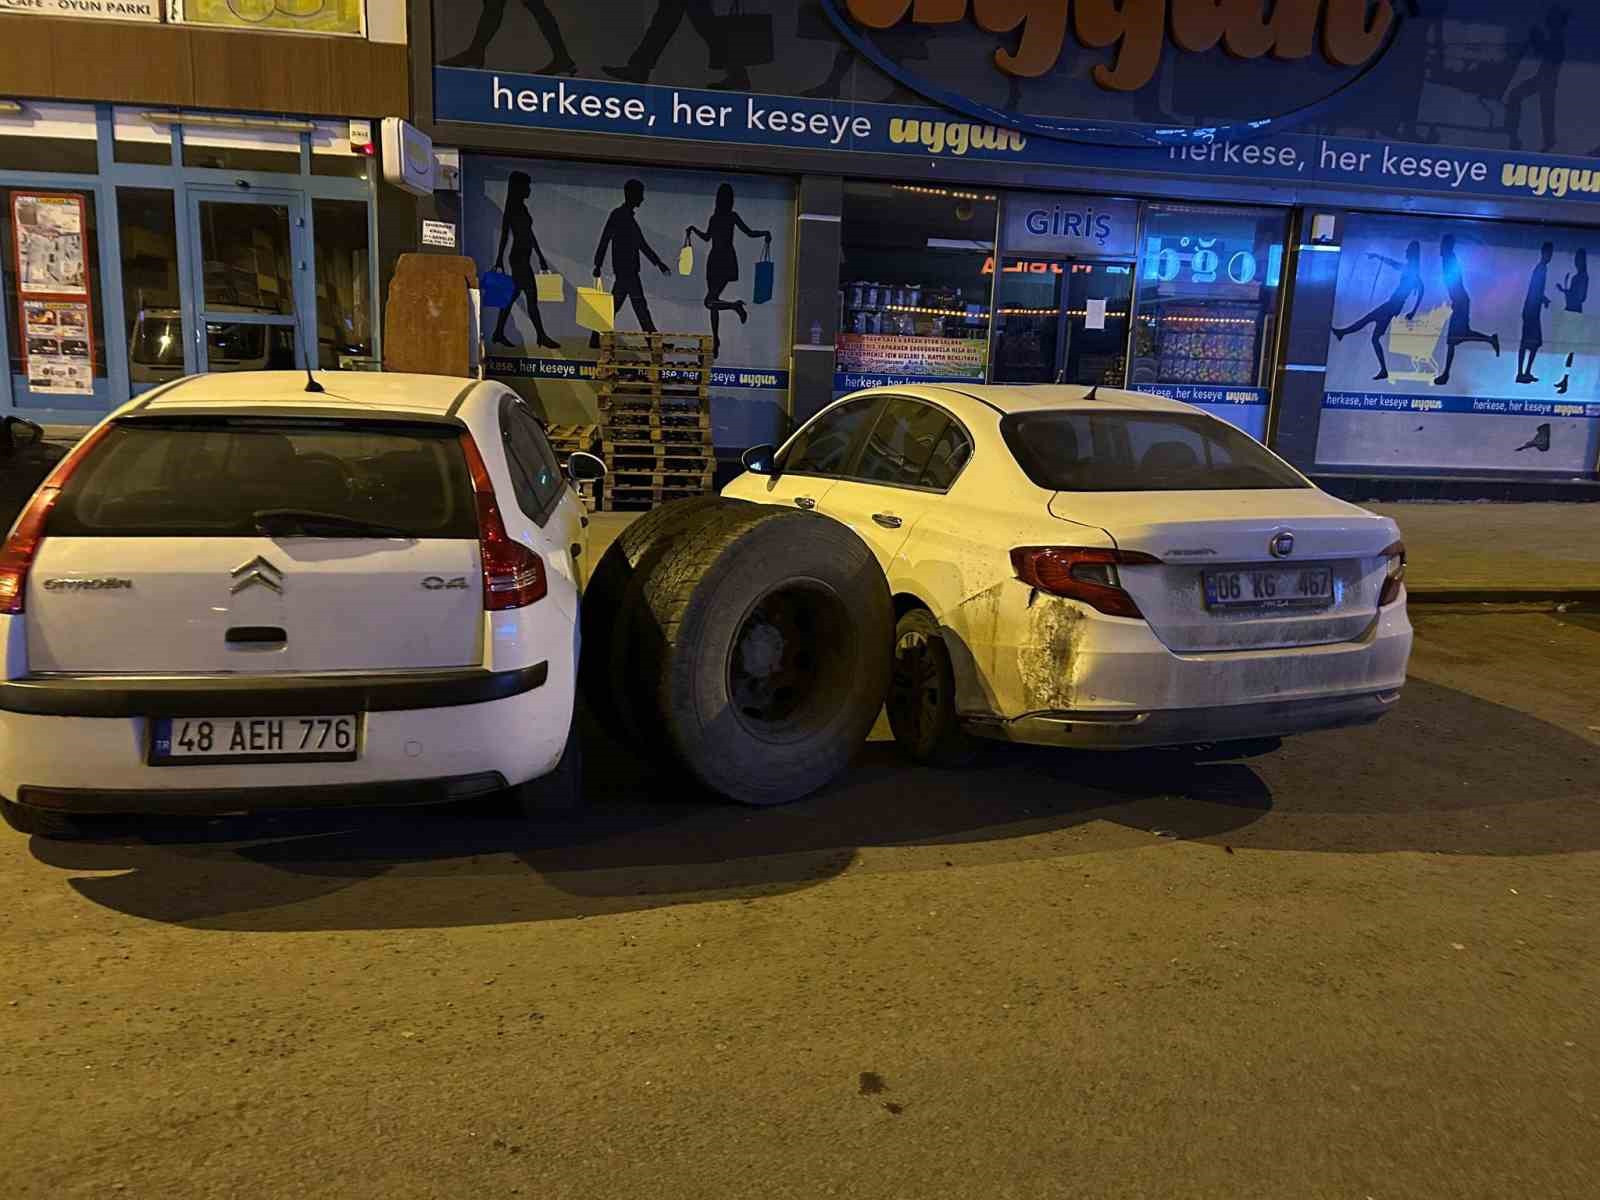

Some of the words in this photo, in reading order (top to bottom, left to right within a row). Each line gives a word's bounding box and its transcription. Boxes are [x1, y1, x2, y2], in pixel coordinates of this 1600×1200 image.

[58, 0, 101, 11] OYUN
[493, 76, 656, 127] herkese,
[673, 92, 732, 127] her
[747, 98, 872, 144] keseye
[889, 117, 1027, 155] uygun
[1320, 141, 1371, 172] her
[1382, 146, 1488, 187] keseye
[1025, 205, 1111, 246] GİRİŞ
[540, 360, 576, 377] keseye
[708, 372, 735, 387] eseye
[739, 374, 777, 388] uygun
[178, 721, 214, 751] 48
[230, 720, 284, 750] AEH
[300, 719, 350, 748] 776
